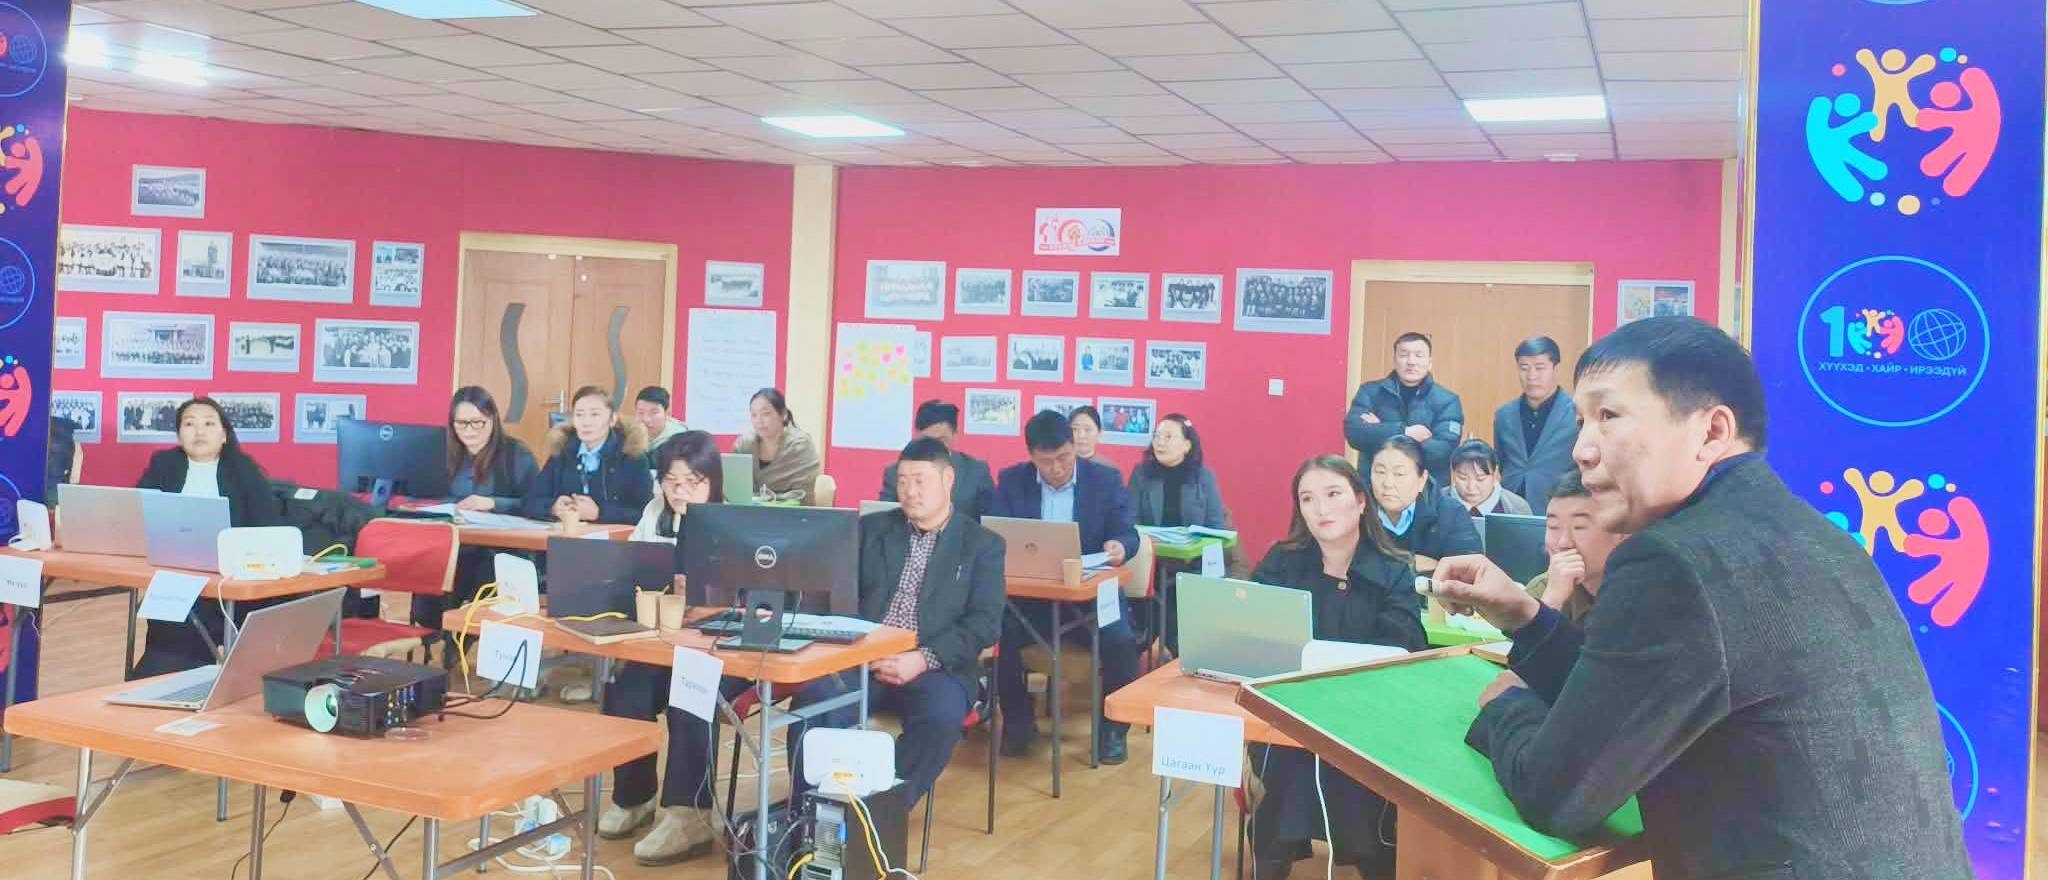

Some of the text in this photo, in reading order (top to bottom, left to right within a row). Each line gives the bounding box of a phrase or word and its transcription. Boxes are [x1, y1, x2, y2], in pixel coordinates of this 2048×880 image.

[1818, 361, 1967, 377] ХҮҮХЭД ХАЙР ИРЭЭДҮЙ
